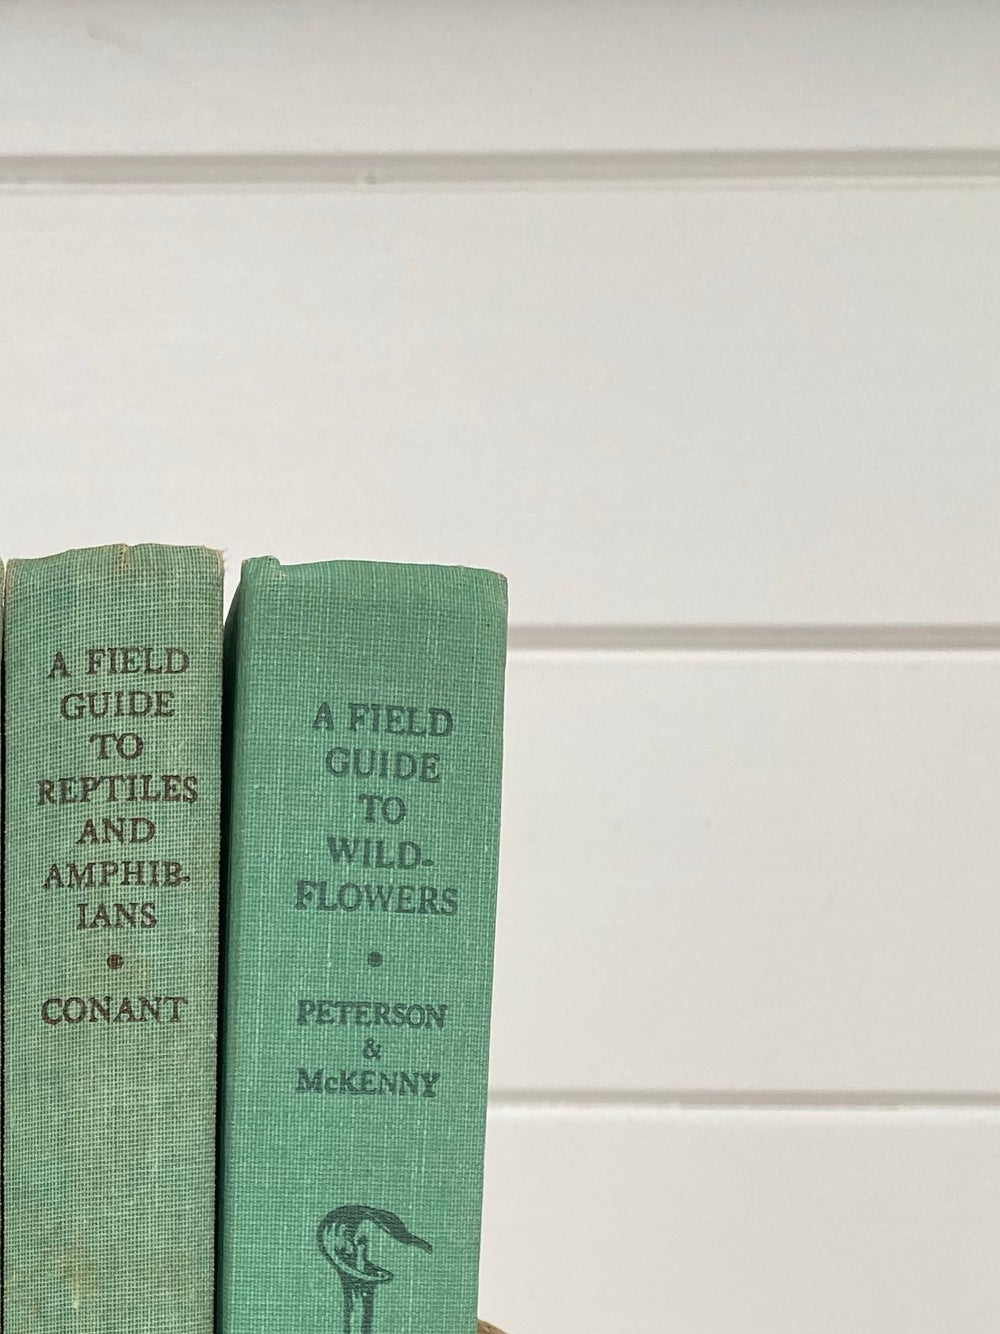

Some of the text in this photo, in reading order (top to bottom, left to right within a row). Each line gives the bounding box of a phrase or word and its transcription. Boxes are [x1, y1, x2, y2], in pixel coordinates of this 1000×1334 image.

[48, 646, 190, 679] A FIELD
[59, 690, 176, 720] GUIDE
[313, 702, 455, 738] A FIELD
[89, 732, 144, 761] TO
[325, 747, 441, 784] GUIDE
[37, 775, 199, 805] REPTILES
[359, 793, 407, 825] TO
[76, 817, 156, 844] AND
[327, 836, 434, 870] WILD-
[43, 862, 190, 889] AMPHIB-
[295, 880, 459, 916] FLOWERS
[76, 902, 158, 930] IANS
[41, 996, 189, 1024] CONANT
[297, 999, 448, 1029] PETERSON
[362, 1037, 381, 1060] &
[296, 1067, 440, 1098] McKENNY
